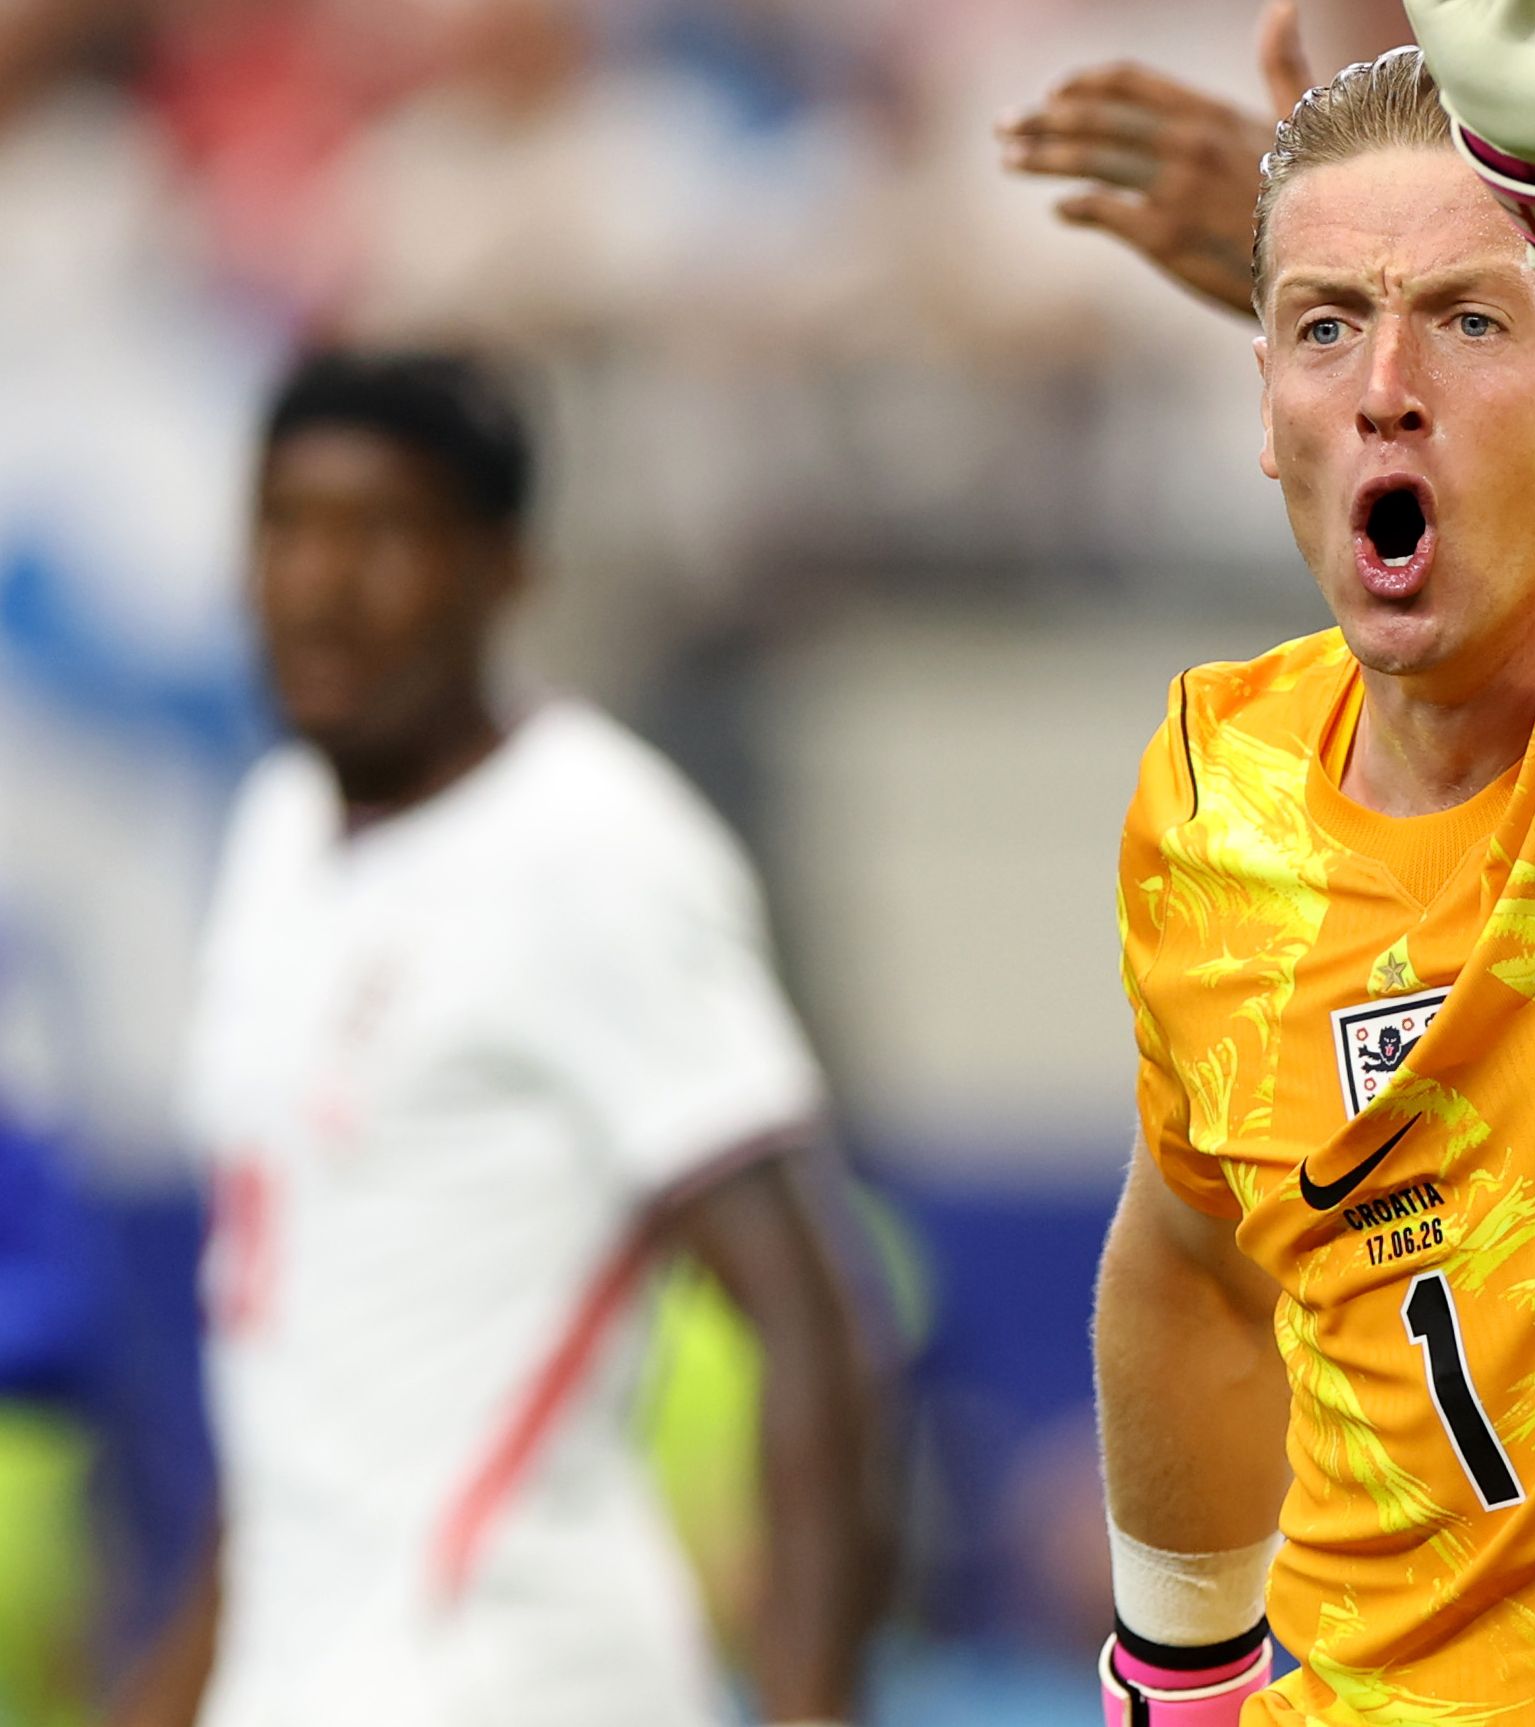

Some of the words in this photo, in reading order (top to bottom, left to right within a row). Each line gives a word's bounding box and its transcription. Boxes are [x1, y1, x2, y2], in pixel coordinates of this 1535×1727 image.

[1342, 1182, 1445, 1231] CROATIA
[1366, 1217, 1444, 1266] 17.06.26
[1400, 1269, 1526, 1512] 1
